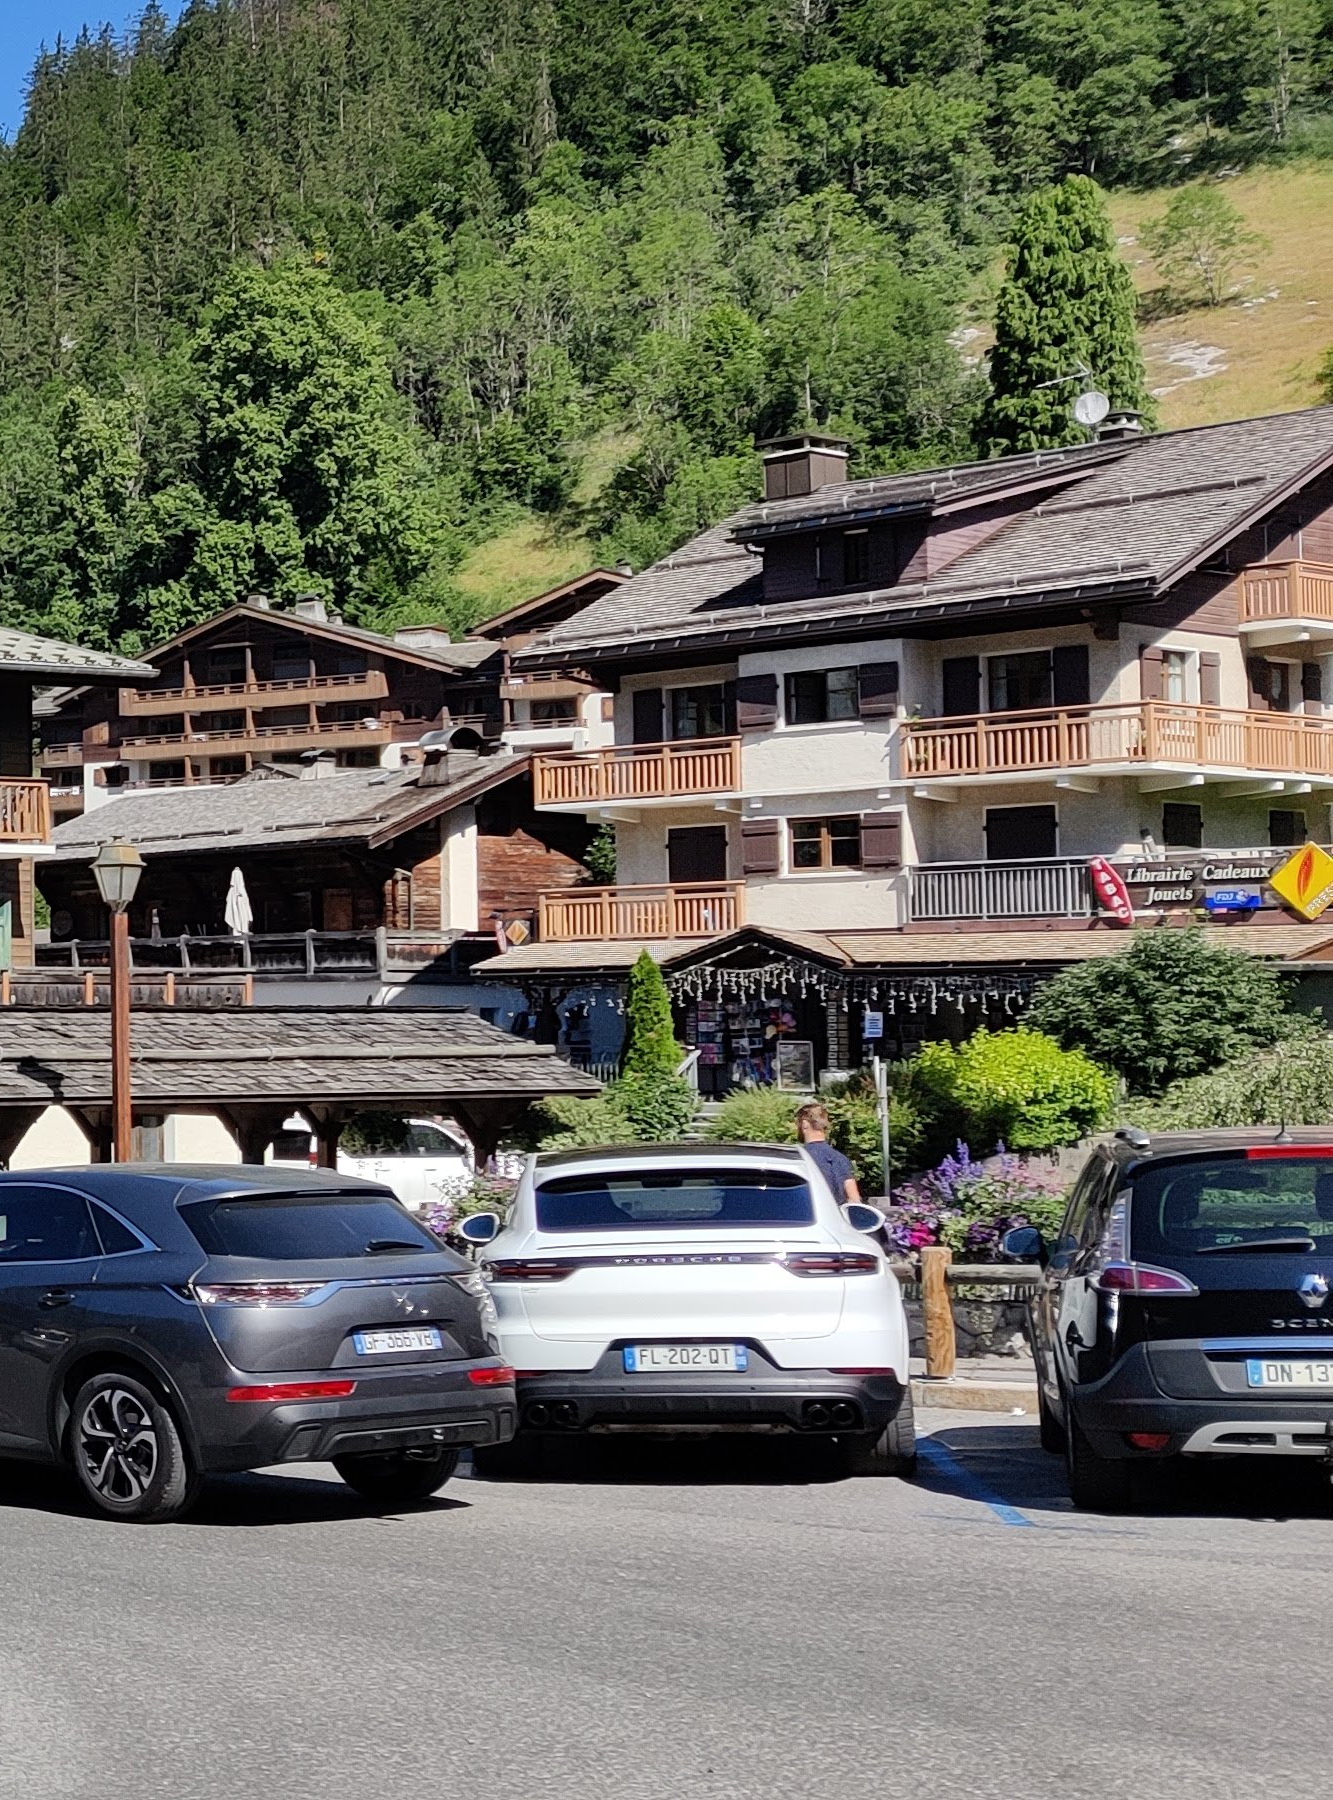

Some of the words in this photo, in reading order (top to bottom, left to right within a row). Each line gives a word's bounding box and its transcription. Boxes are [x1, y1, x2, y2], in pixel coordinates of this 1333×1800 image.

[1126, 867, 1194, 884] Librairie
[1202, 864, 1271, 881] Cadeaux
[1091, 857, 1131, 919] TABAC
[1145, 886, 1193, 906] Jouets
[1216, 891, 1235, 903] FDJ
[639, 1349, 730, 1365] FL-202-QT
